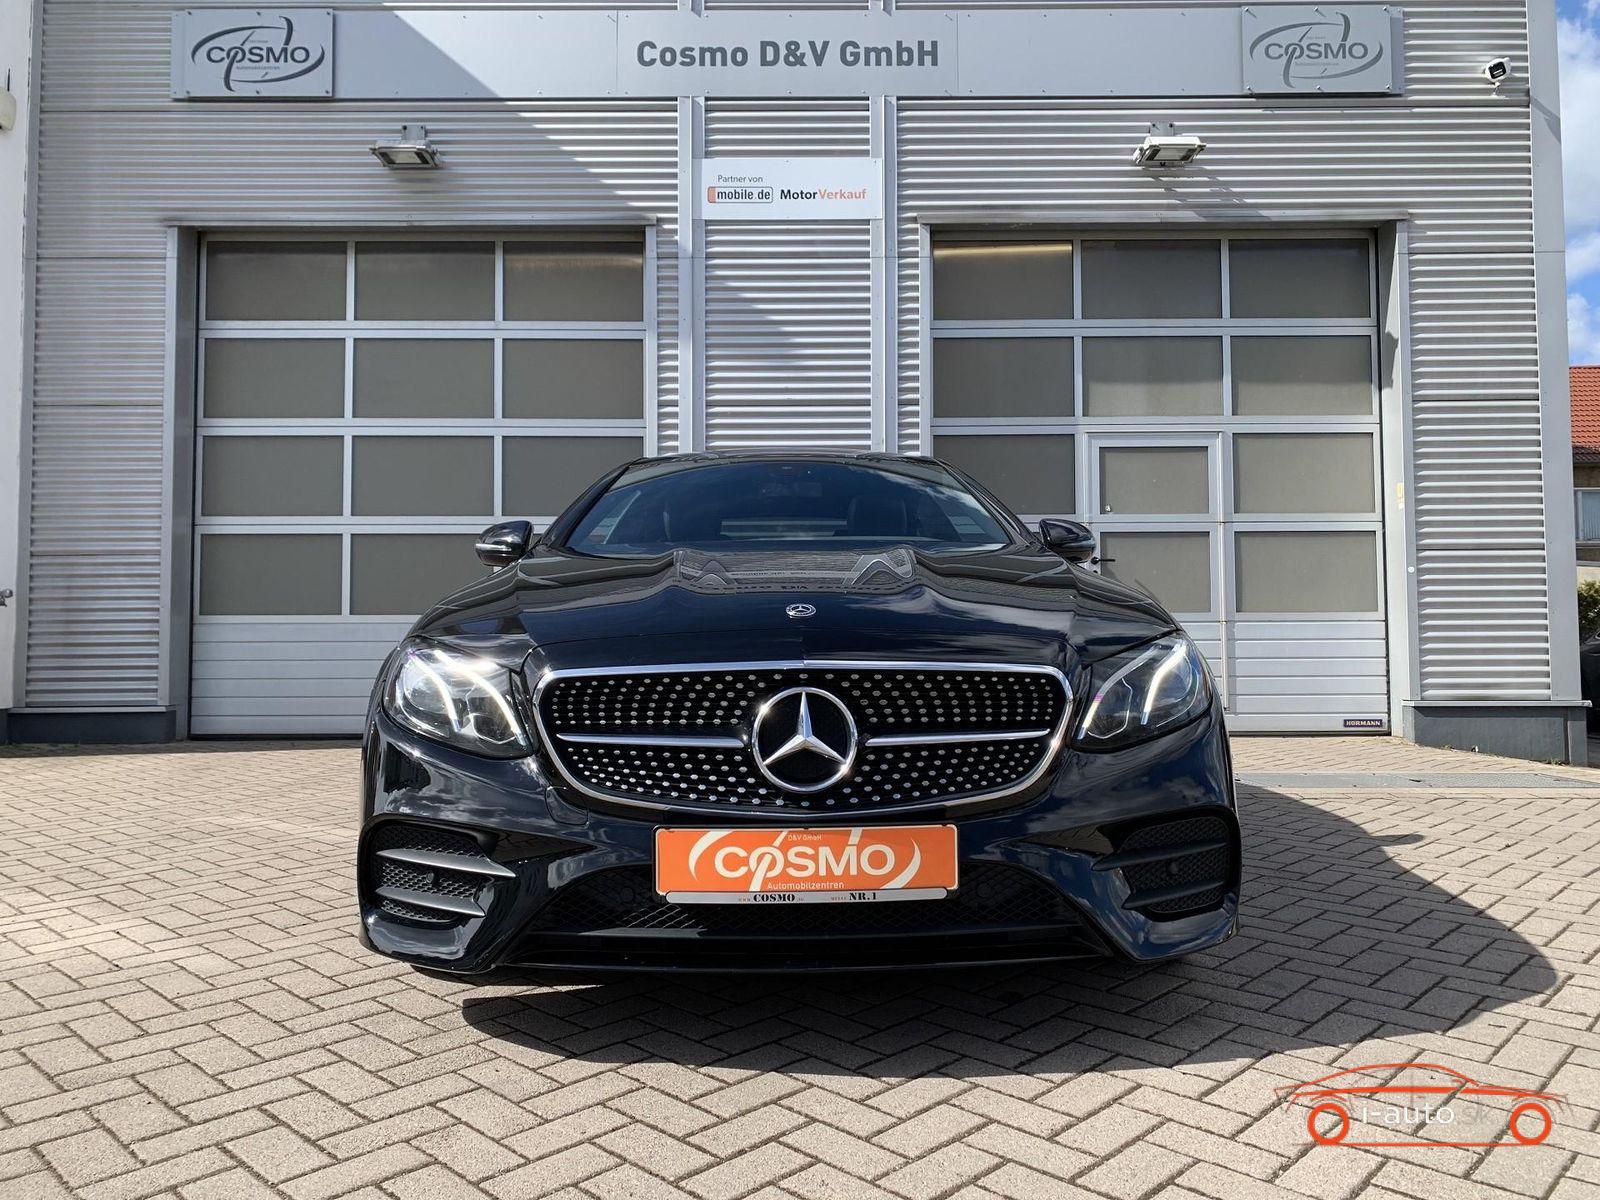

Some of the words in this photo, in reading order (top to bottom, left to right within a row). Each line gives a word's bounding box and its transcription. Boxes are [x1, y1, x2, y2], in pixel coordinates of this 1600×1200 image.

[206, 46, 310, 63] COSMO
[636, 40, 749, 67] Cosmo
[759, 40, 830, 67] D&V
[839, 40, 939, 67] GmbH
[1264, 42, 1369, 60] COSMO
[717, 174, 746, 183] Partner
[716, 188, 771, 200] mobile.de
[714, 844, 896, 878] COSMO
[767, 881, 845, 890] Automobilzentren
[753, 893, 796, 902] COSMO
